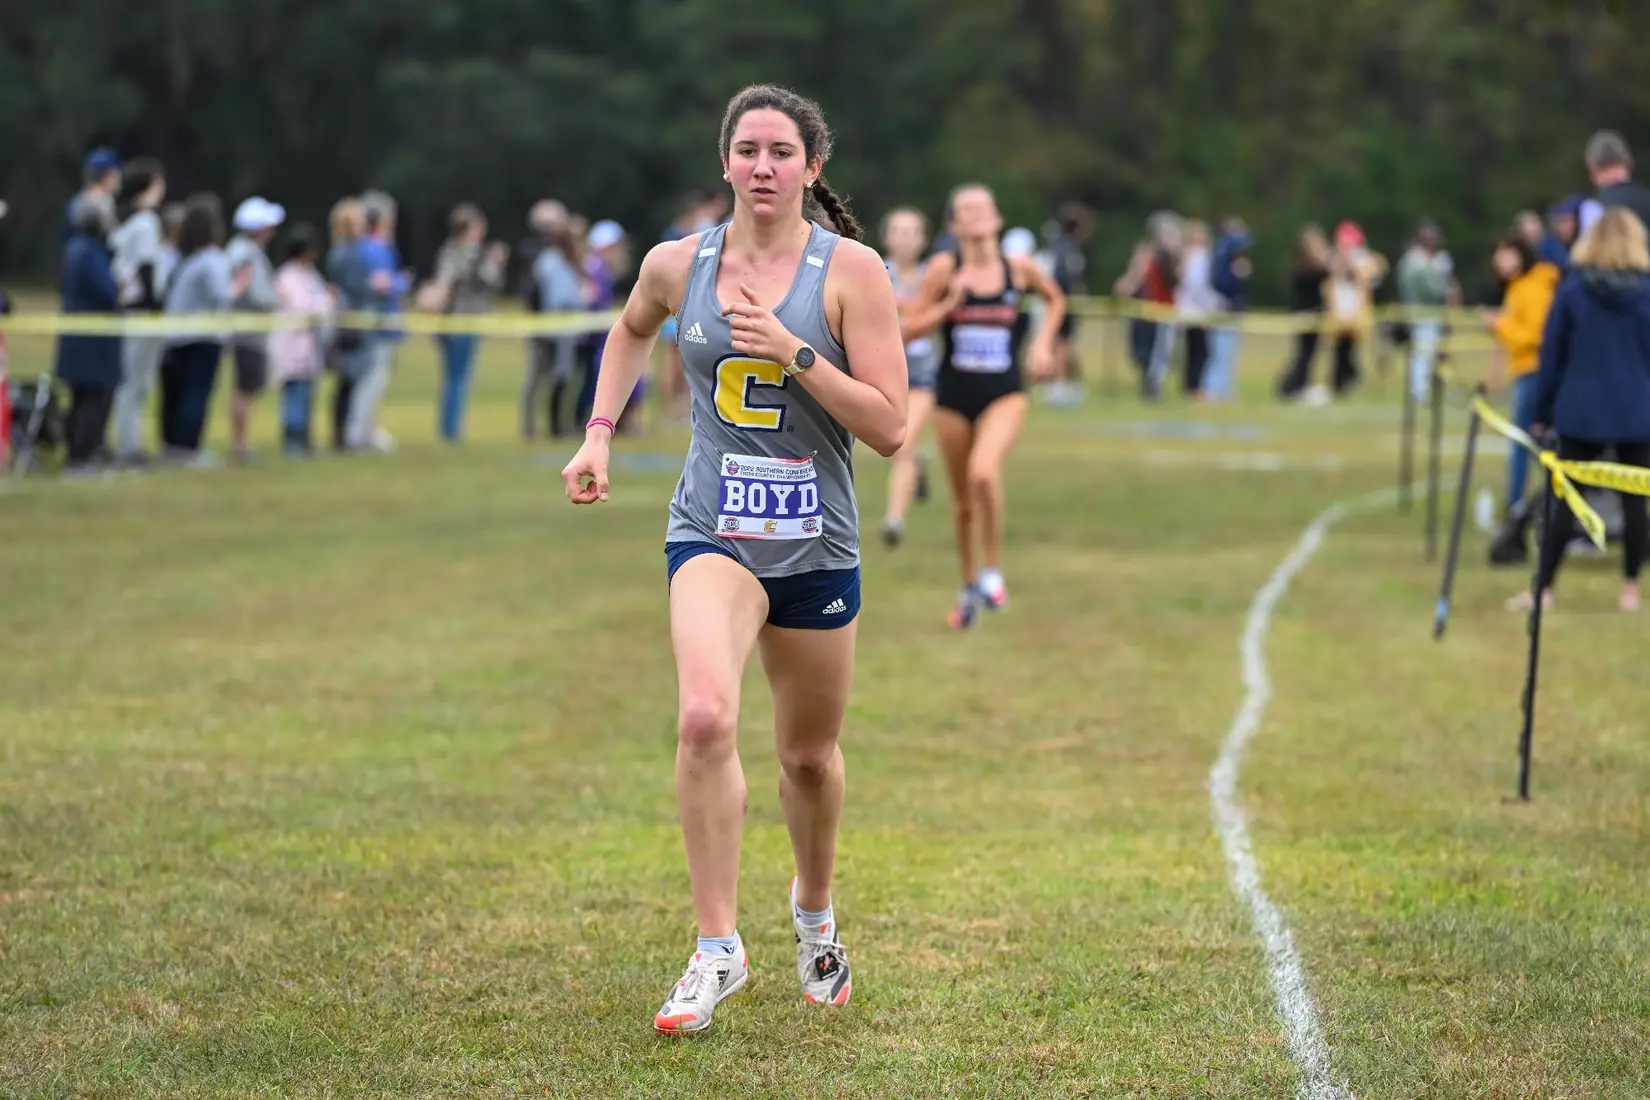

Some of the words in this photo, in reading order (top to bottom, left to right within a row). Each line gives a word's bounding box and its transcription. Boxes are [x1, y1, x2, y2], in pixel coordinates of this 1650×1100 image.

[684, 334, 708, 345] adidas
[711, 353, 789, 432] C
[741, 465, 755, 473] 2022
[756, 466, 785, 475] SOUTHERN
[723, 479, 818, 515] BOYD
[822, 605, 847, 615] adidas
